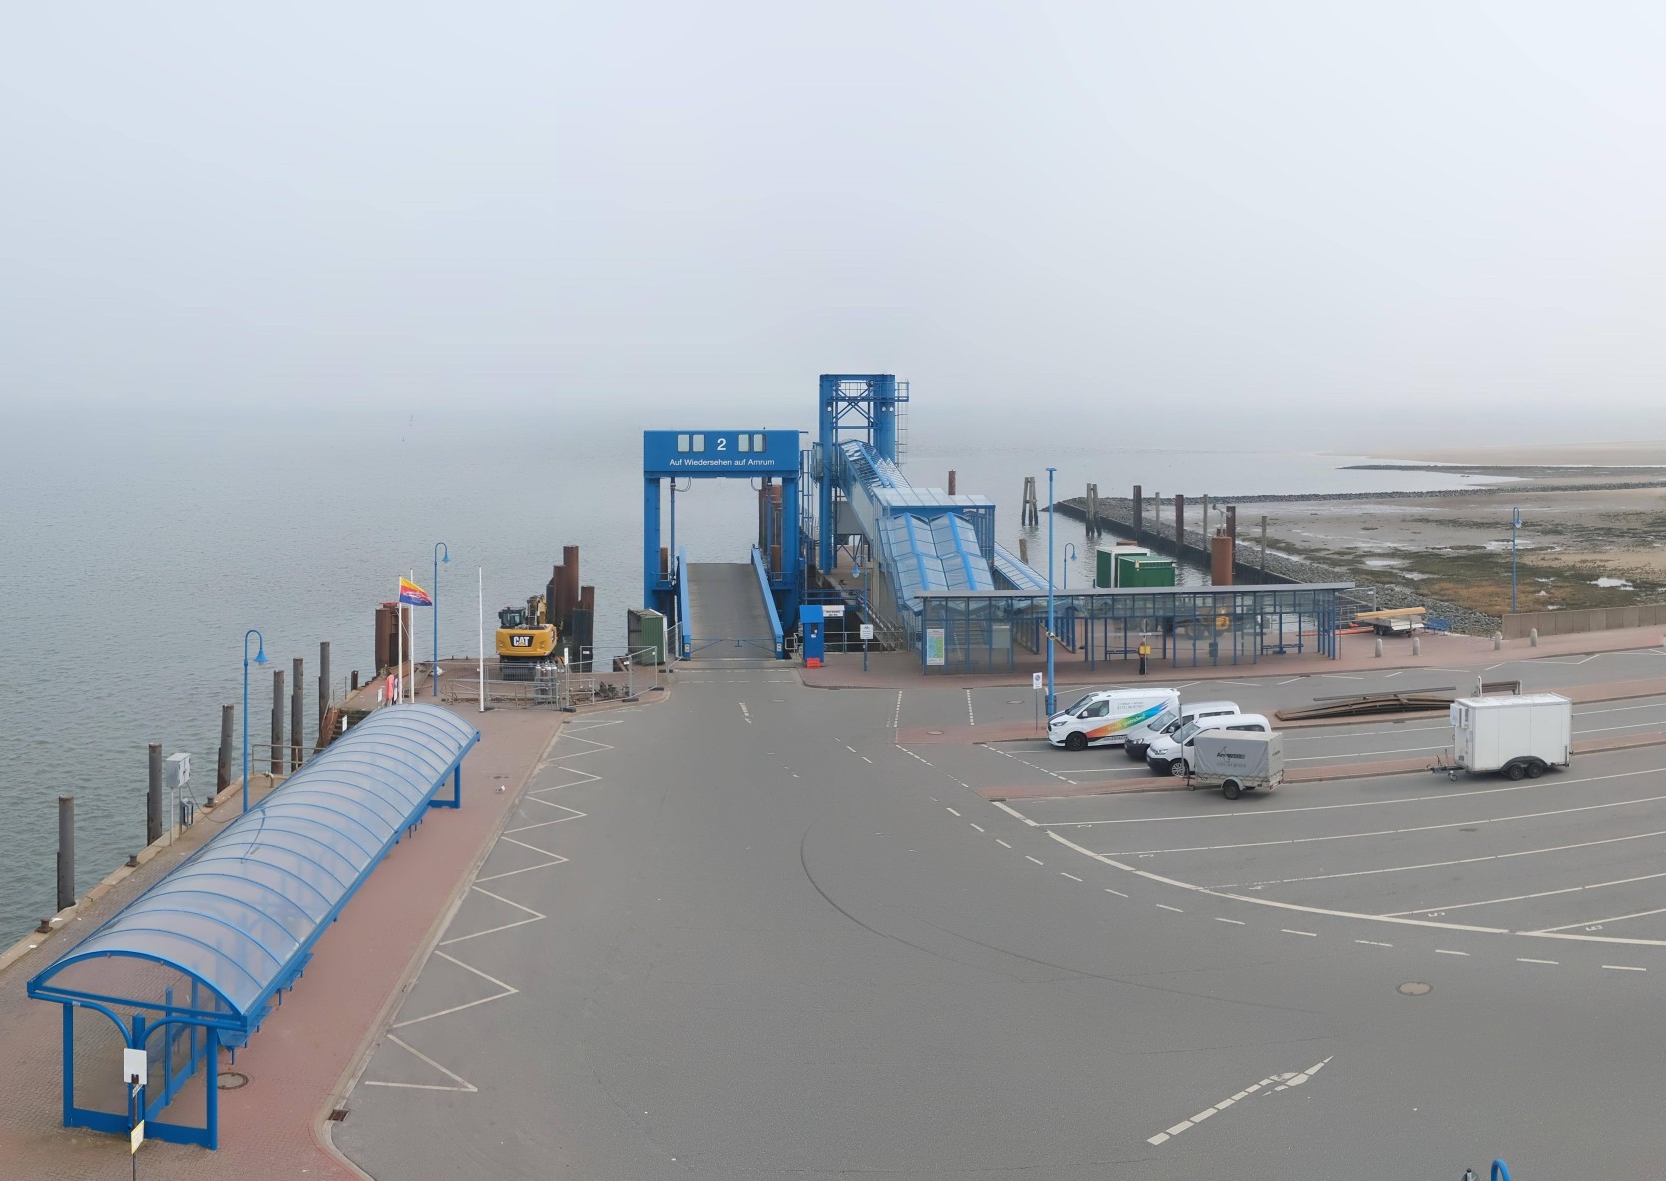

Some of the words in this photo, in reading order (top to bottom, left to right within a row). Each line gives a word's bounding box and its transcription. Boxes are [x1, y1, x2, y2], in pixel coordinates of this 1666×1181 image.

[717, 438, 727, 451] 2
[669, 458, 682, 466] Auf
[684, 458, 733, 466] Wiedersehen
[734, 458, 746, 466] auf
[747, 458, 775, 466] Amrum
[513, 636, 530, 647] CAT
